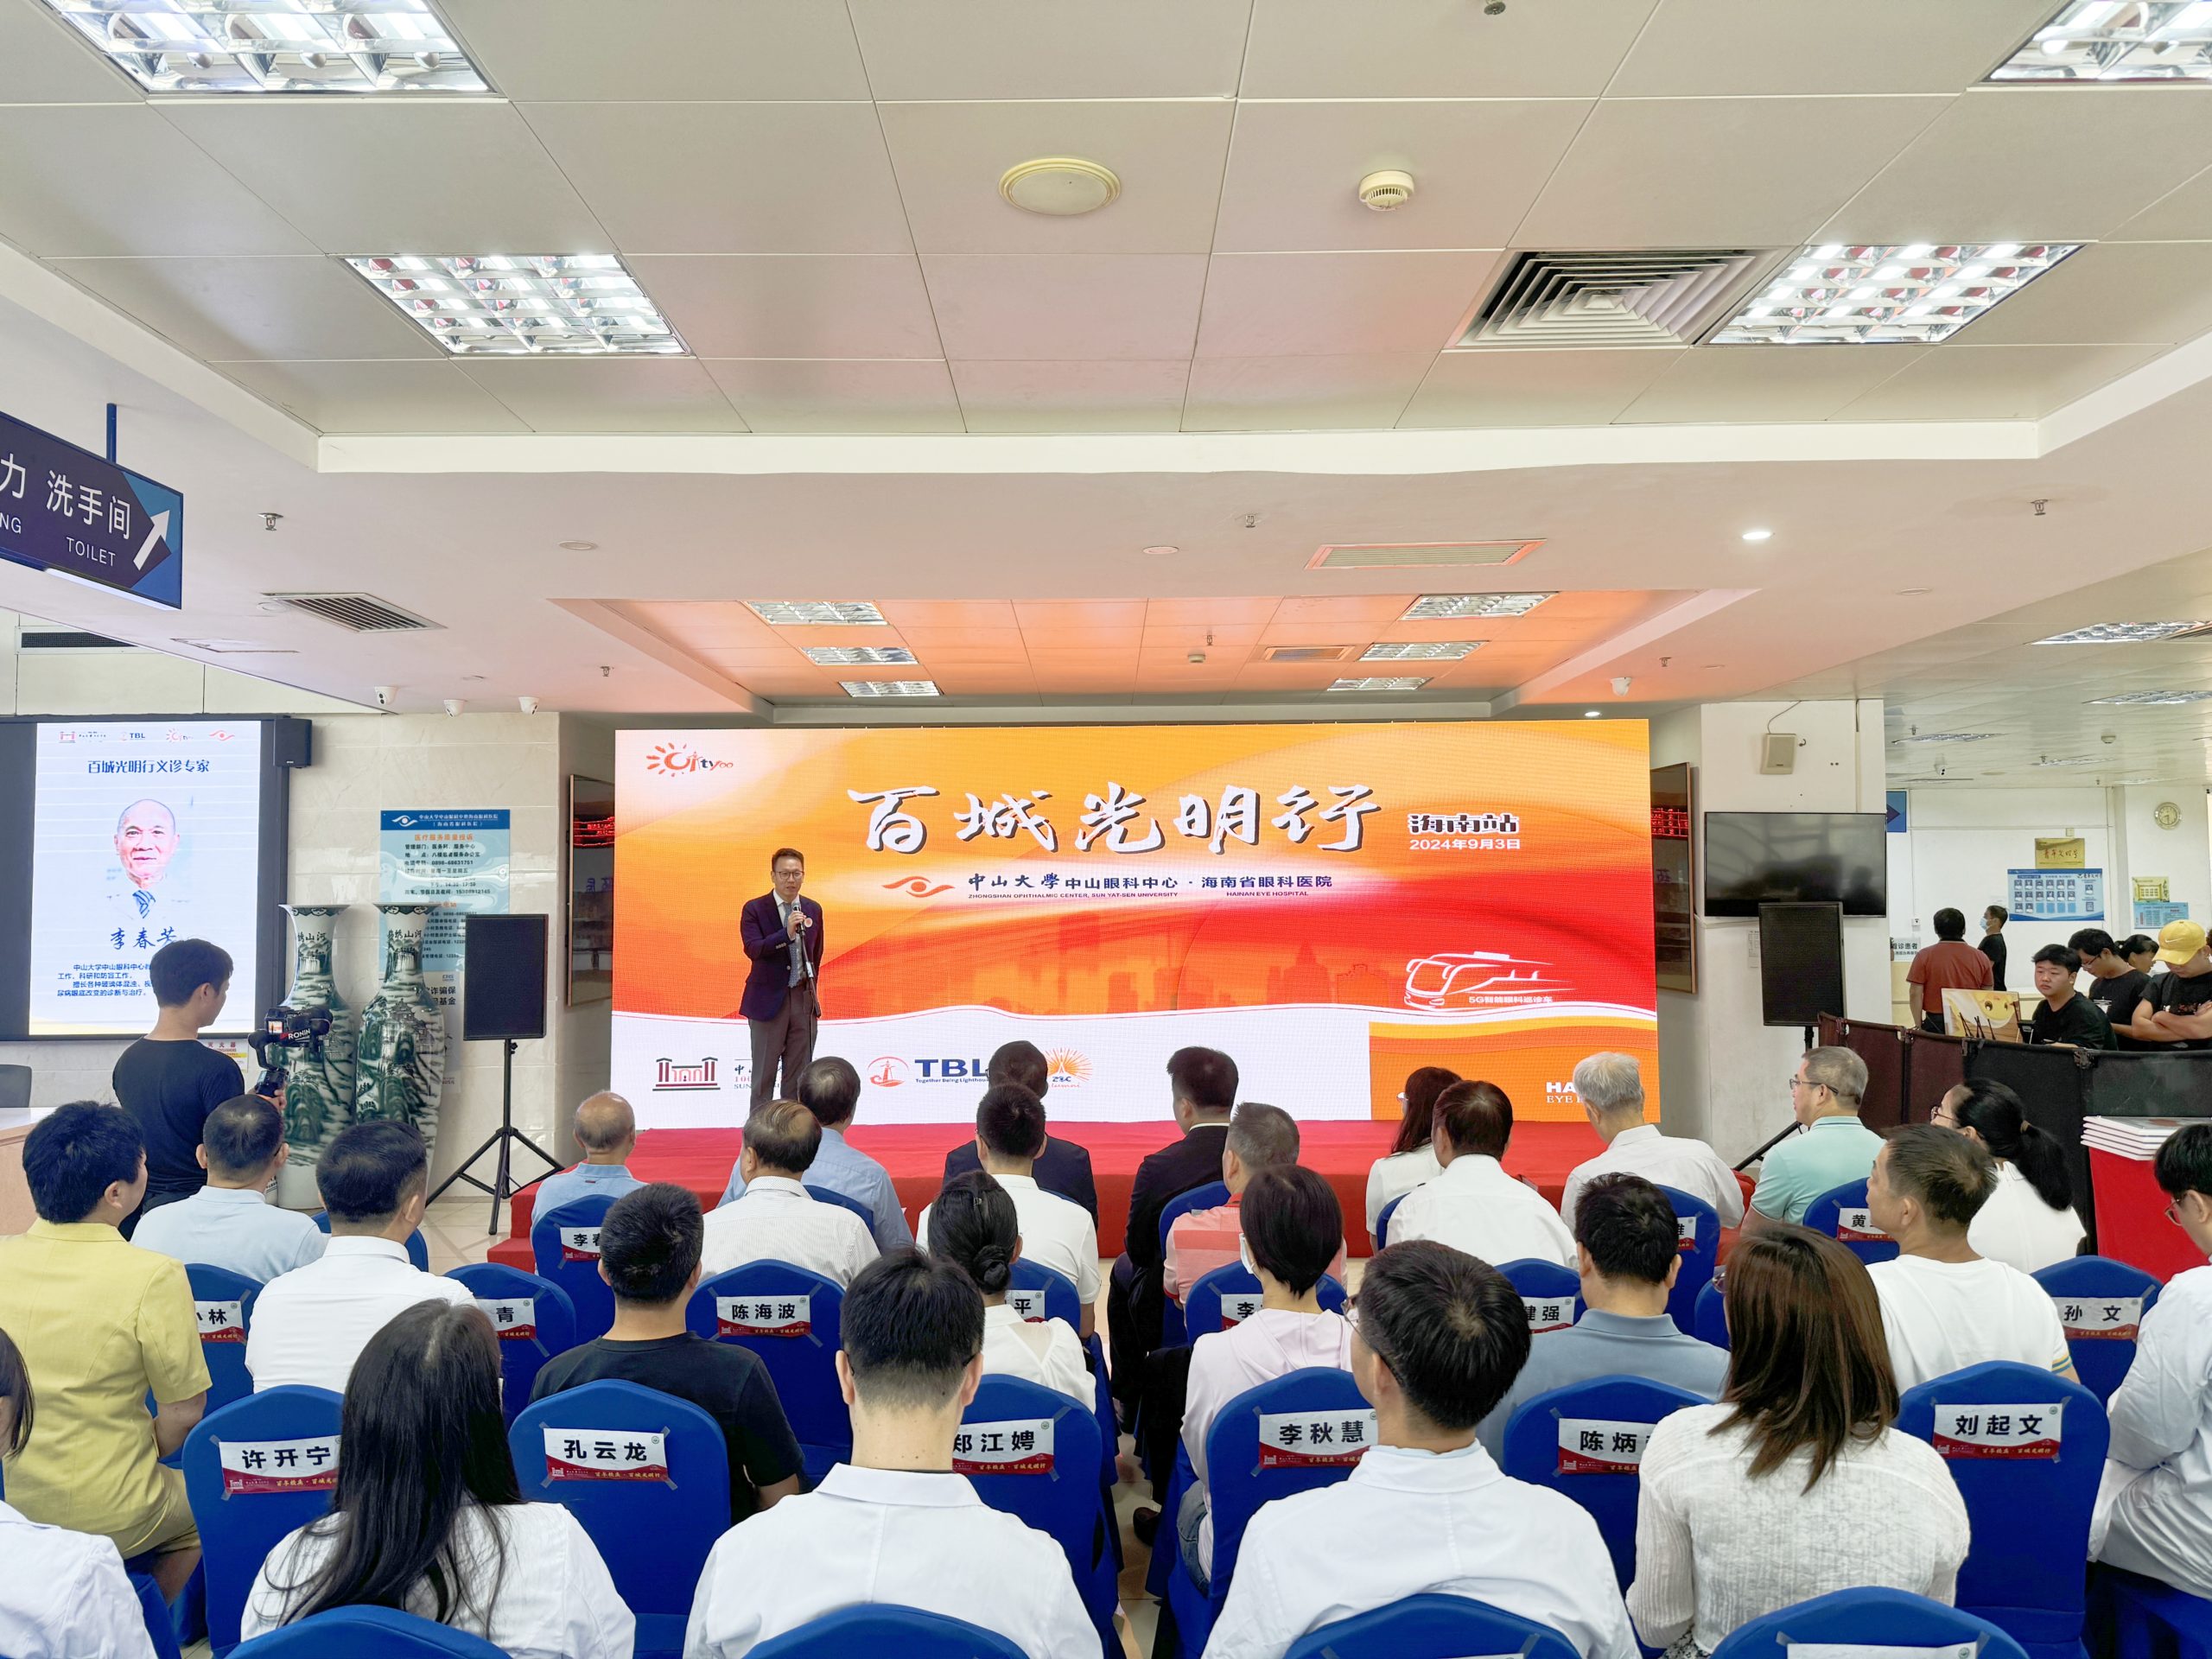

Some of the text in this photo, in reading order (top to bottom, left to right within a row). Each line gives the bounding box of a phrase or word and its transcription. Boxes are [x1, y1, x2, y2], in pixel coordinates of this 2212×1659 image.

[46, 469, 130, 540] 洗手间
[67, 536, 116, 568] TOILET
[87, 760, 210, 773] 百城光明行义诊专家
[847, 781, 1382, 855] 百城光明行
[1408, 813, 1521, 834] 海南站
[1409, 838, 1521, 851] 2024年9月3日
[427, 986, 456, 995] 诈骗保
[288, 1028, 311, 1040] RONIN
[914, 1058, 987, 1077] TBL
[1546, 1082, 1576, 1093] HA
[496, 1306, 514, 1323] 青
[732, 1304, 796, 1319] 陈海波
[1014, 1299, 1032, 1314] 平
[1279, 1420, 1364, 1446] 李秋慧
[1955, 1414, 2043, 1436] 刘起文
[563, 1440, 647, 1461] 孔云龙
[1580, 1430, 1650, 1452] 陈炳
[241, 1445, 332, 1470] 许开宁
